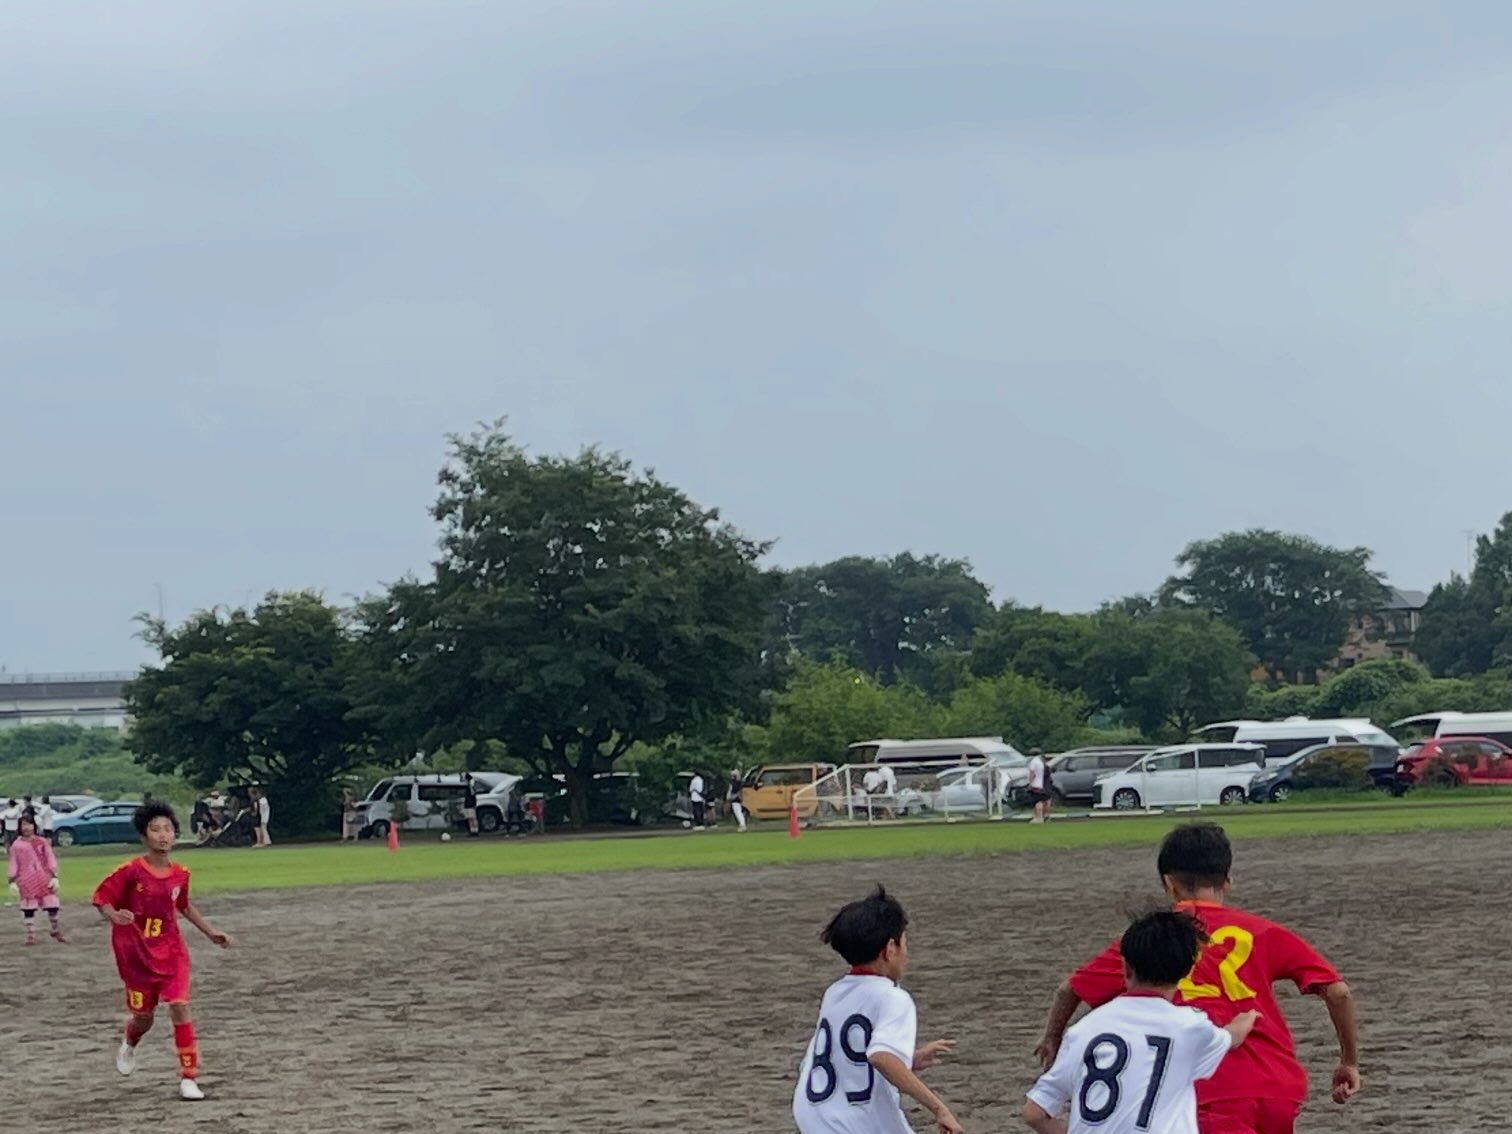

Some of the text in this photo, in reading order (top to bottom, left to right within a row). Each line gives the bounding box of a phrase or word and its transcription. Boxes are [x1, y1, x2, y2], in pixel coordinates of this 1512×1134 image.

[143, 917, 163, 938] 13
[806, 1013, 874, 1103] 89
[1079, 1032, 1173, 1131] 81
